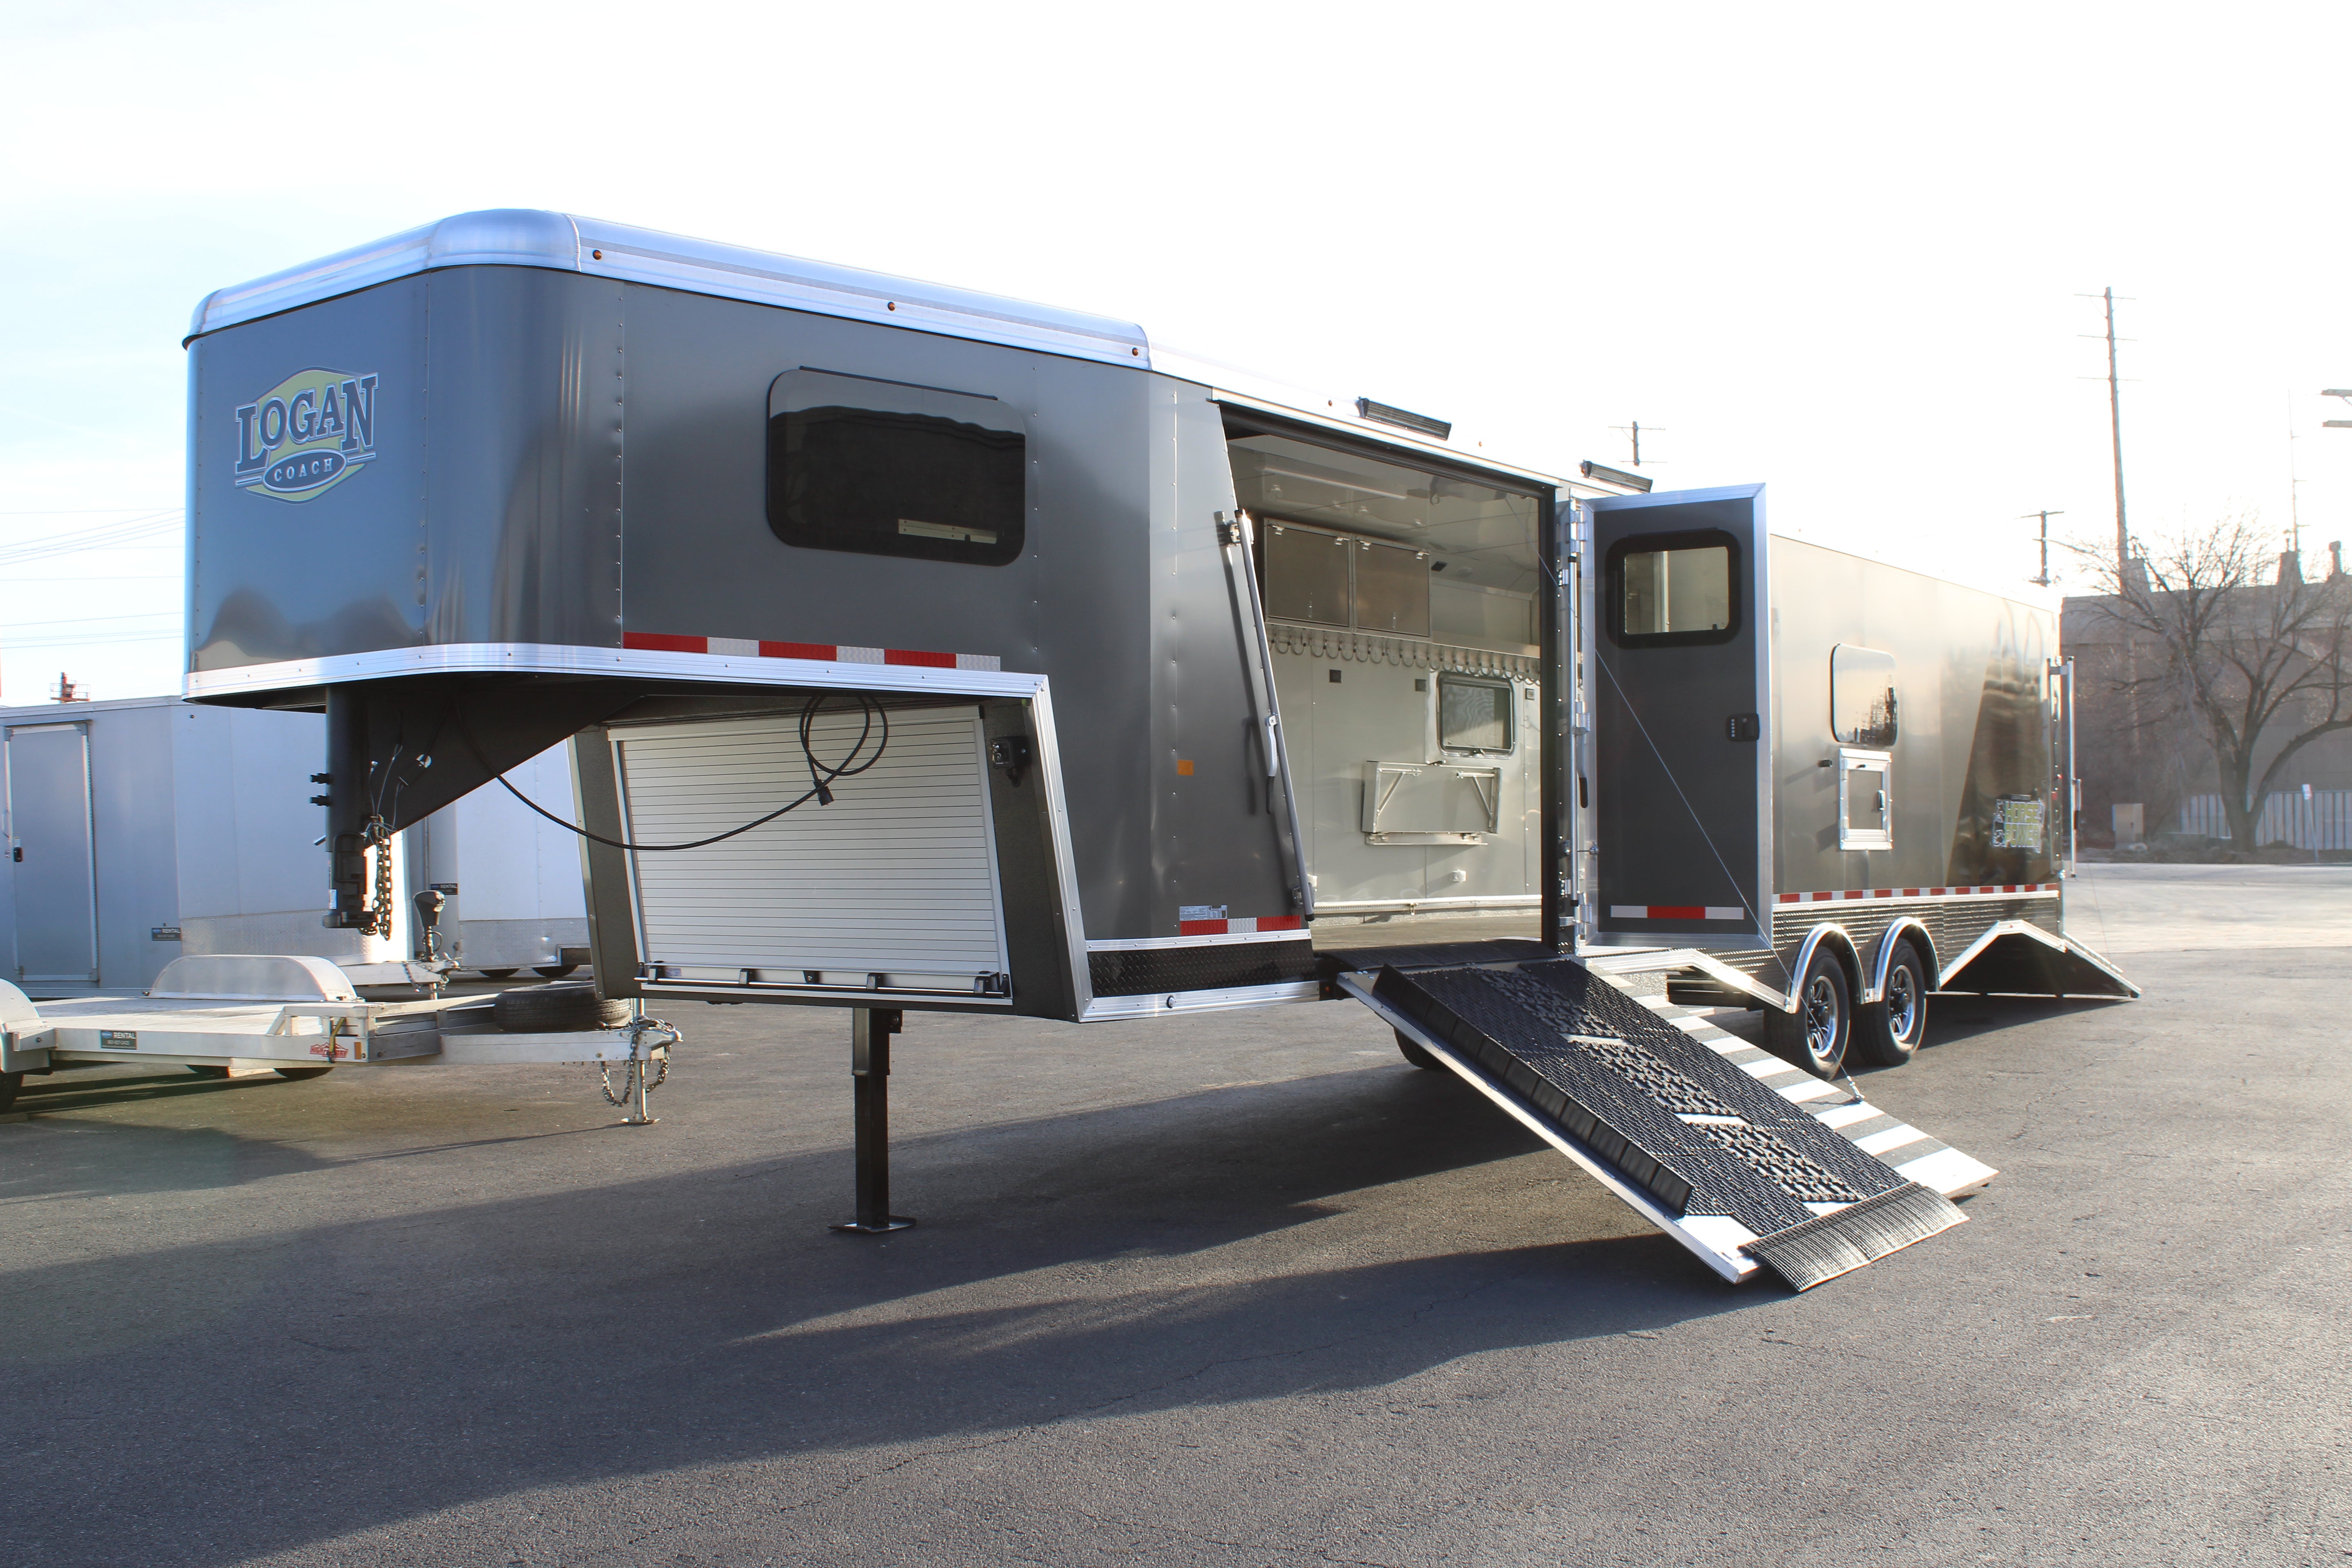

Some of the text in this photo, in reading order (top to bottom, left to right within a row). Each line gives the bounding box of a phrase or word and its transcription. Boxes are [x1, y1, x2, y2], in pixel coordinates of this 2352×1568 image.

[235, 372, 379, 476] LOGAN
[274, 458, 333, 482] COACH
[2005, 801, 2040, 823] HORSE
[2004, 823, 2040, 847] POWER
